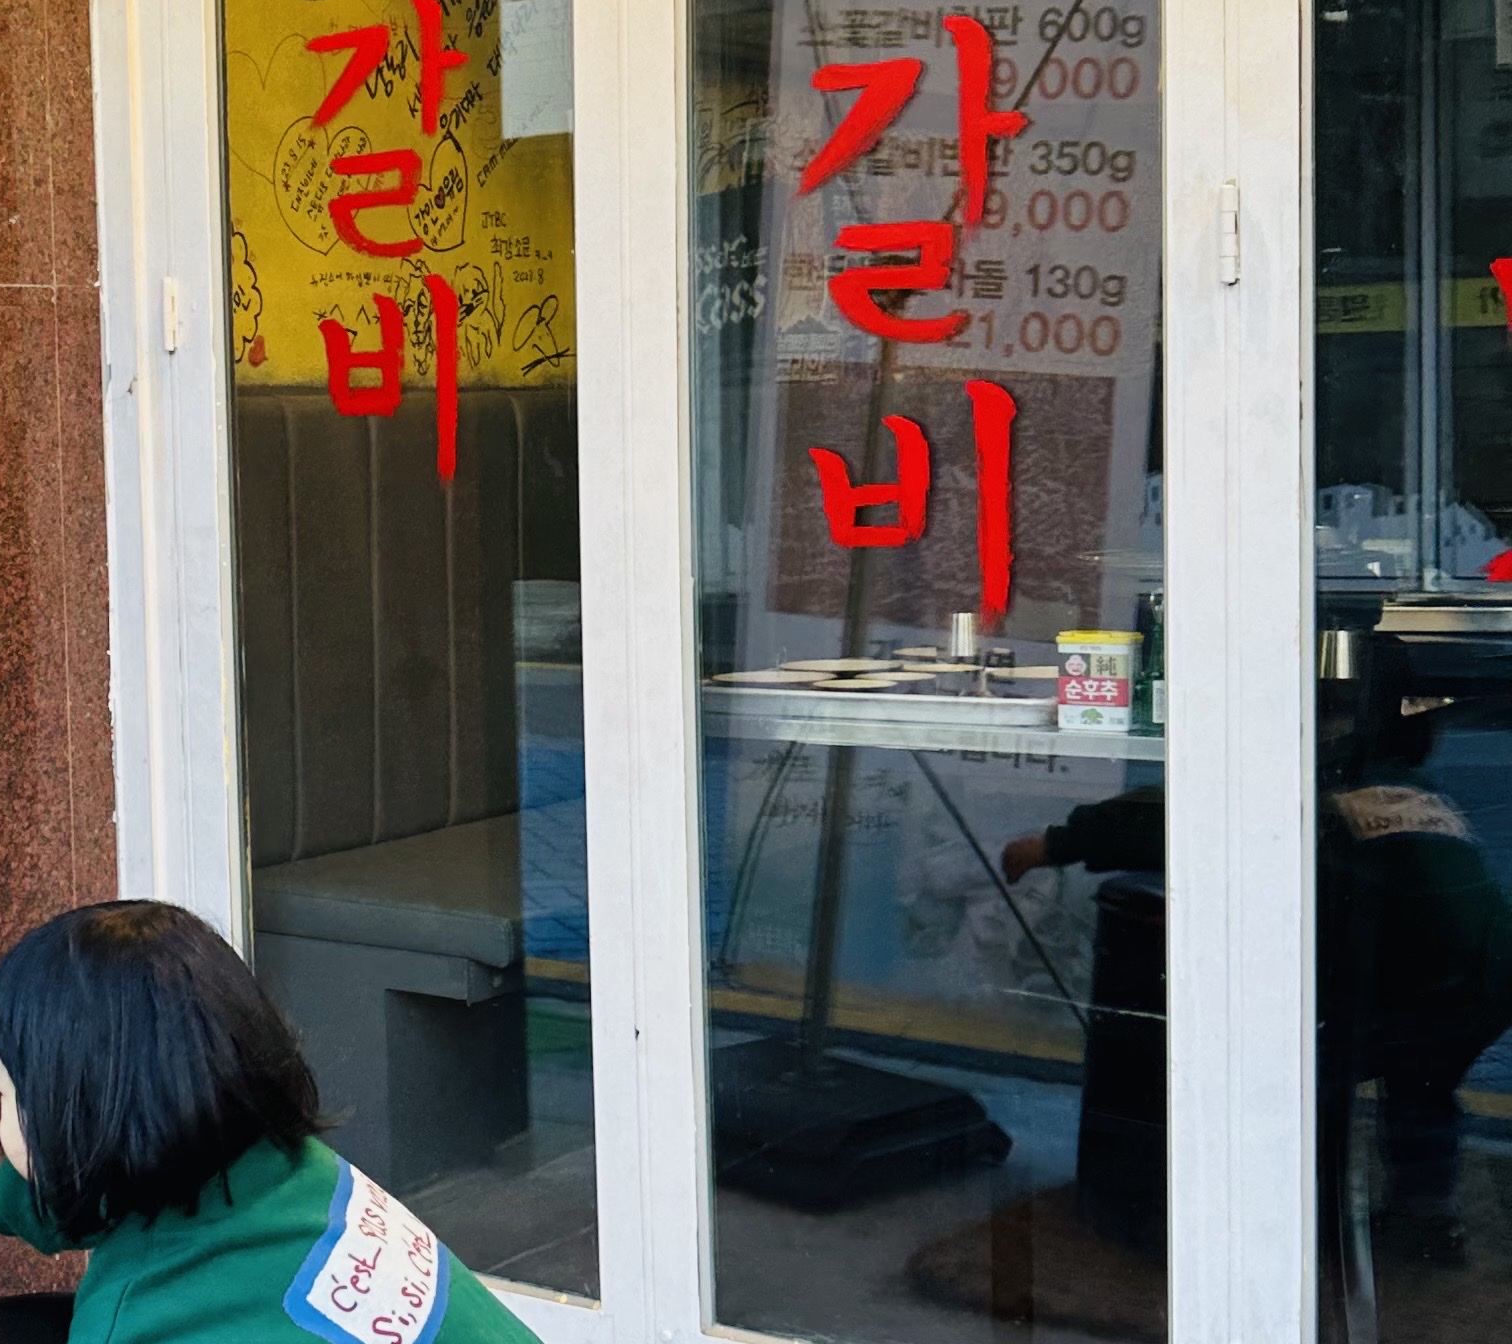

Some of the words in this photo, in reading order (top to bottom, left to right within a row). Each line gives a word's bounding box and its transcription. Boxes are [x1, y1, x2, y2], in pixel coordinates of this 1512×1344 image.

[1029, 139, 1136, 183] 350g
[1025, 263, 1128, 306] 130g
[1065, 679, 1119, 701] 순후추
